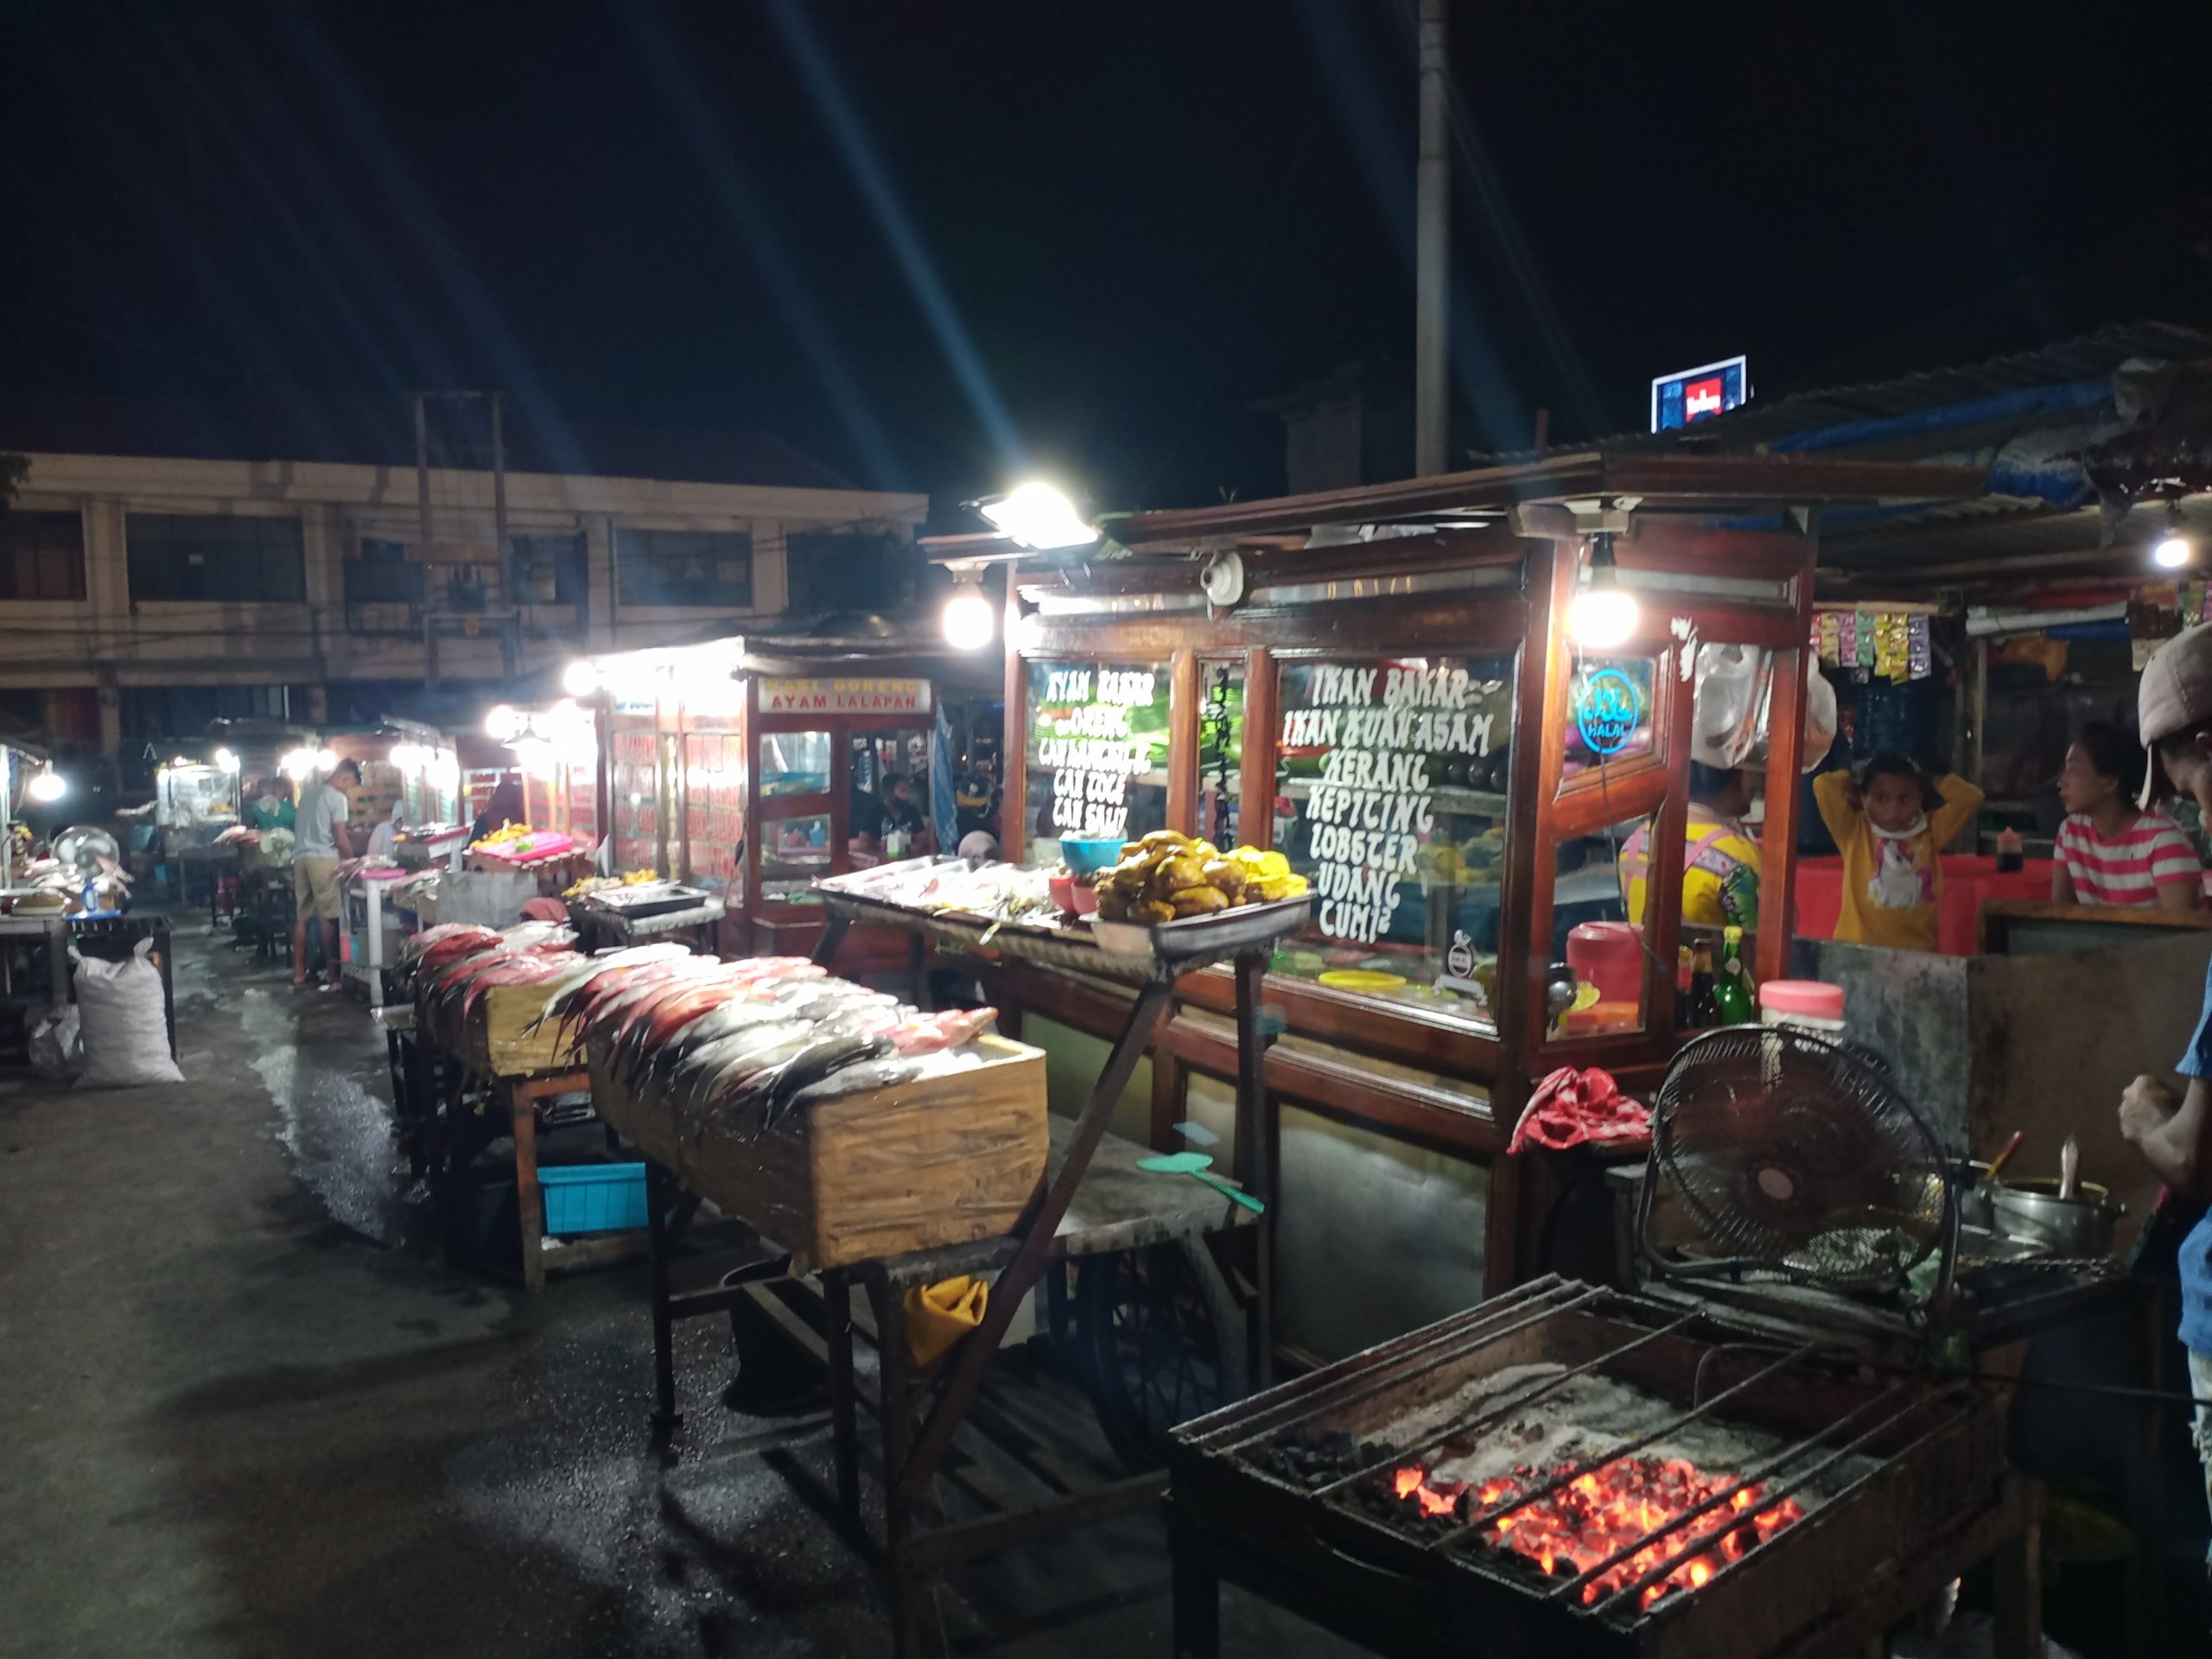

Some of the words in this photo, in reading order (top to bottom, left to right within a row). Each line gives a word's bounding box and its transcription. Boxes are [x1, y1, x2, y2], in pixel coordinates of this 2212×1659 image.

[772, 694, 827, 709] AYAM
[836, 694, 918, 709] LALAPAN
[1046, 670, 1091, 703] AYAM
[1312, 667, 1378, 707] IKAN
[1383, 668, 1470, 710] BAKAR
[1282, 709, 1342, 747] IKAN
[1341, 709, 1413, 750] KUAH
[1414, 711, 1495, 758] ASAM
[1586, 724, 1628, 738] HALAL
[1323, 748, 1430, 794] KERANG
[1306, 785, 1435, 836] KEPITING
[1309, 822, 1420, 875] LOBSTER
[1318, 861, 1402, 910] UDANG
